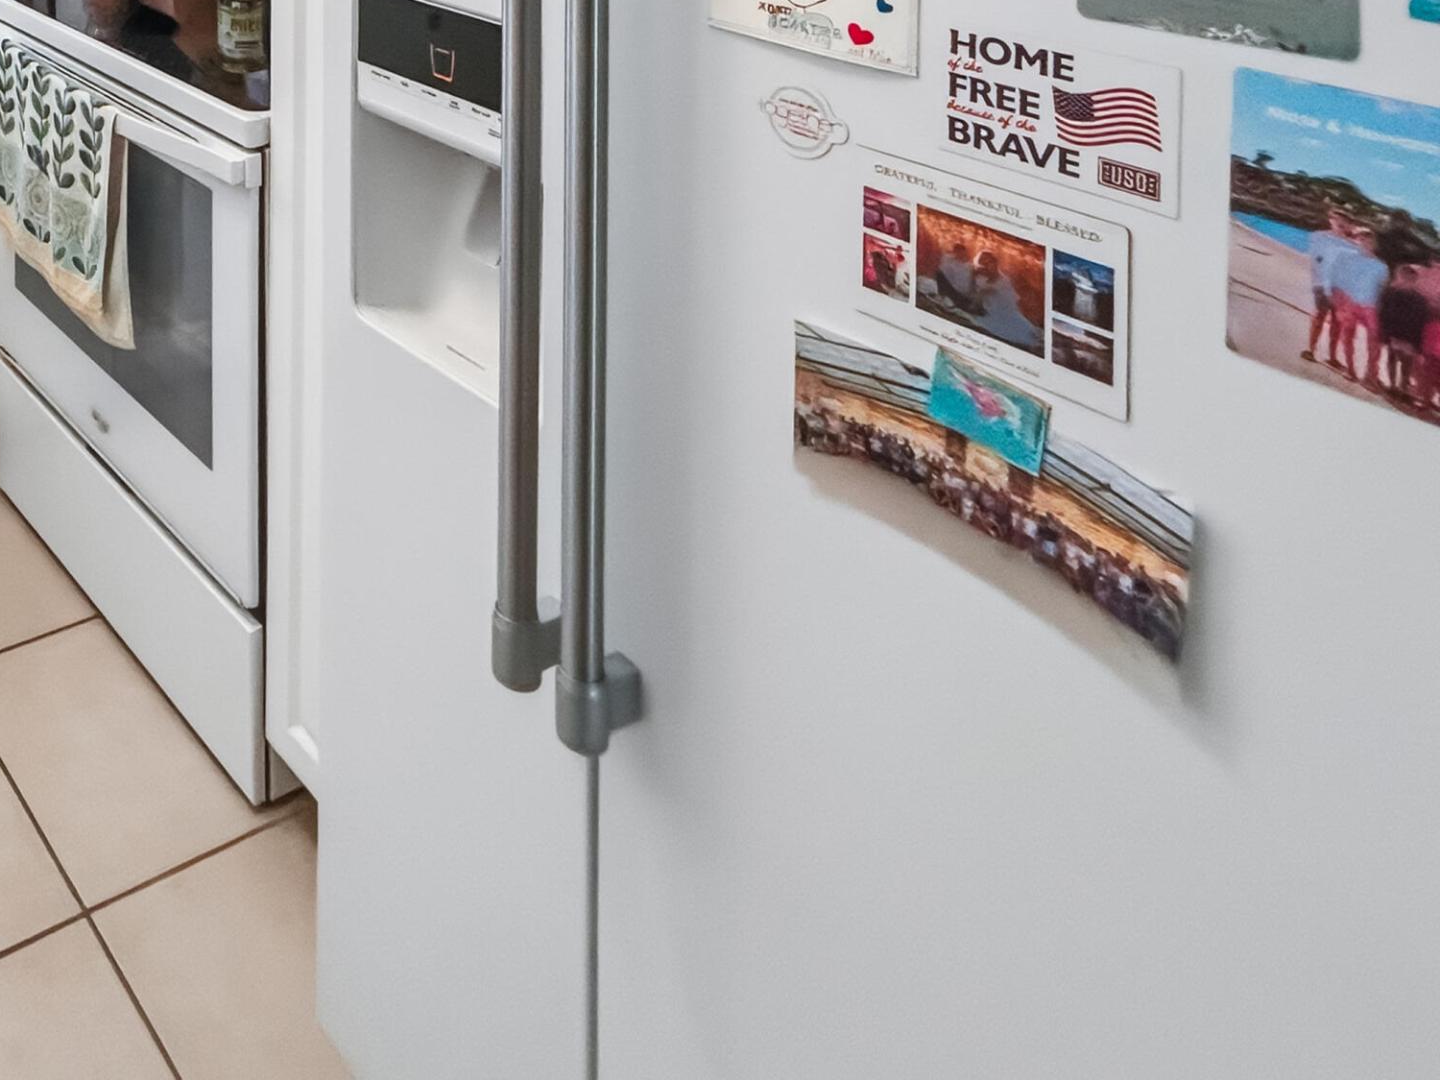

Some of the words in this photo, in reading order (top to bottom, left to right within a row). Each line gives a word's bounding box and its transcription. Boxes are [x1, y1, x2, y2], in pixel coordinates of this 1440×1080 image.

[947, 57, 961, 70] of
[963, 60, 983, 73] the
[949, 29, 1074, 82] HOME
[948, 71, 1041, 120] FREE
[947, 115, 1080, 179] BRAVE
[997, 113, 1014, 129] of
[1015, 118, 1037, 133] the
